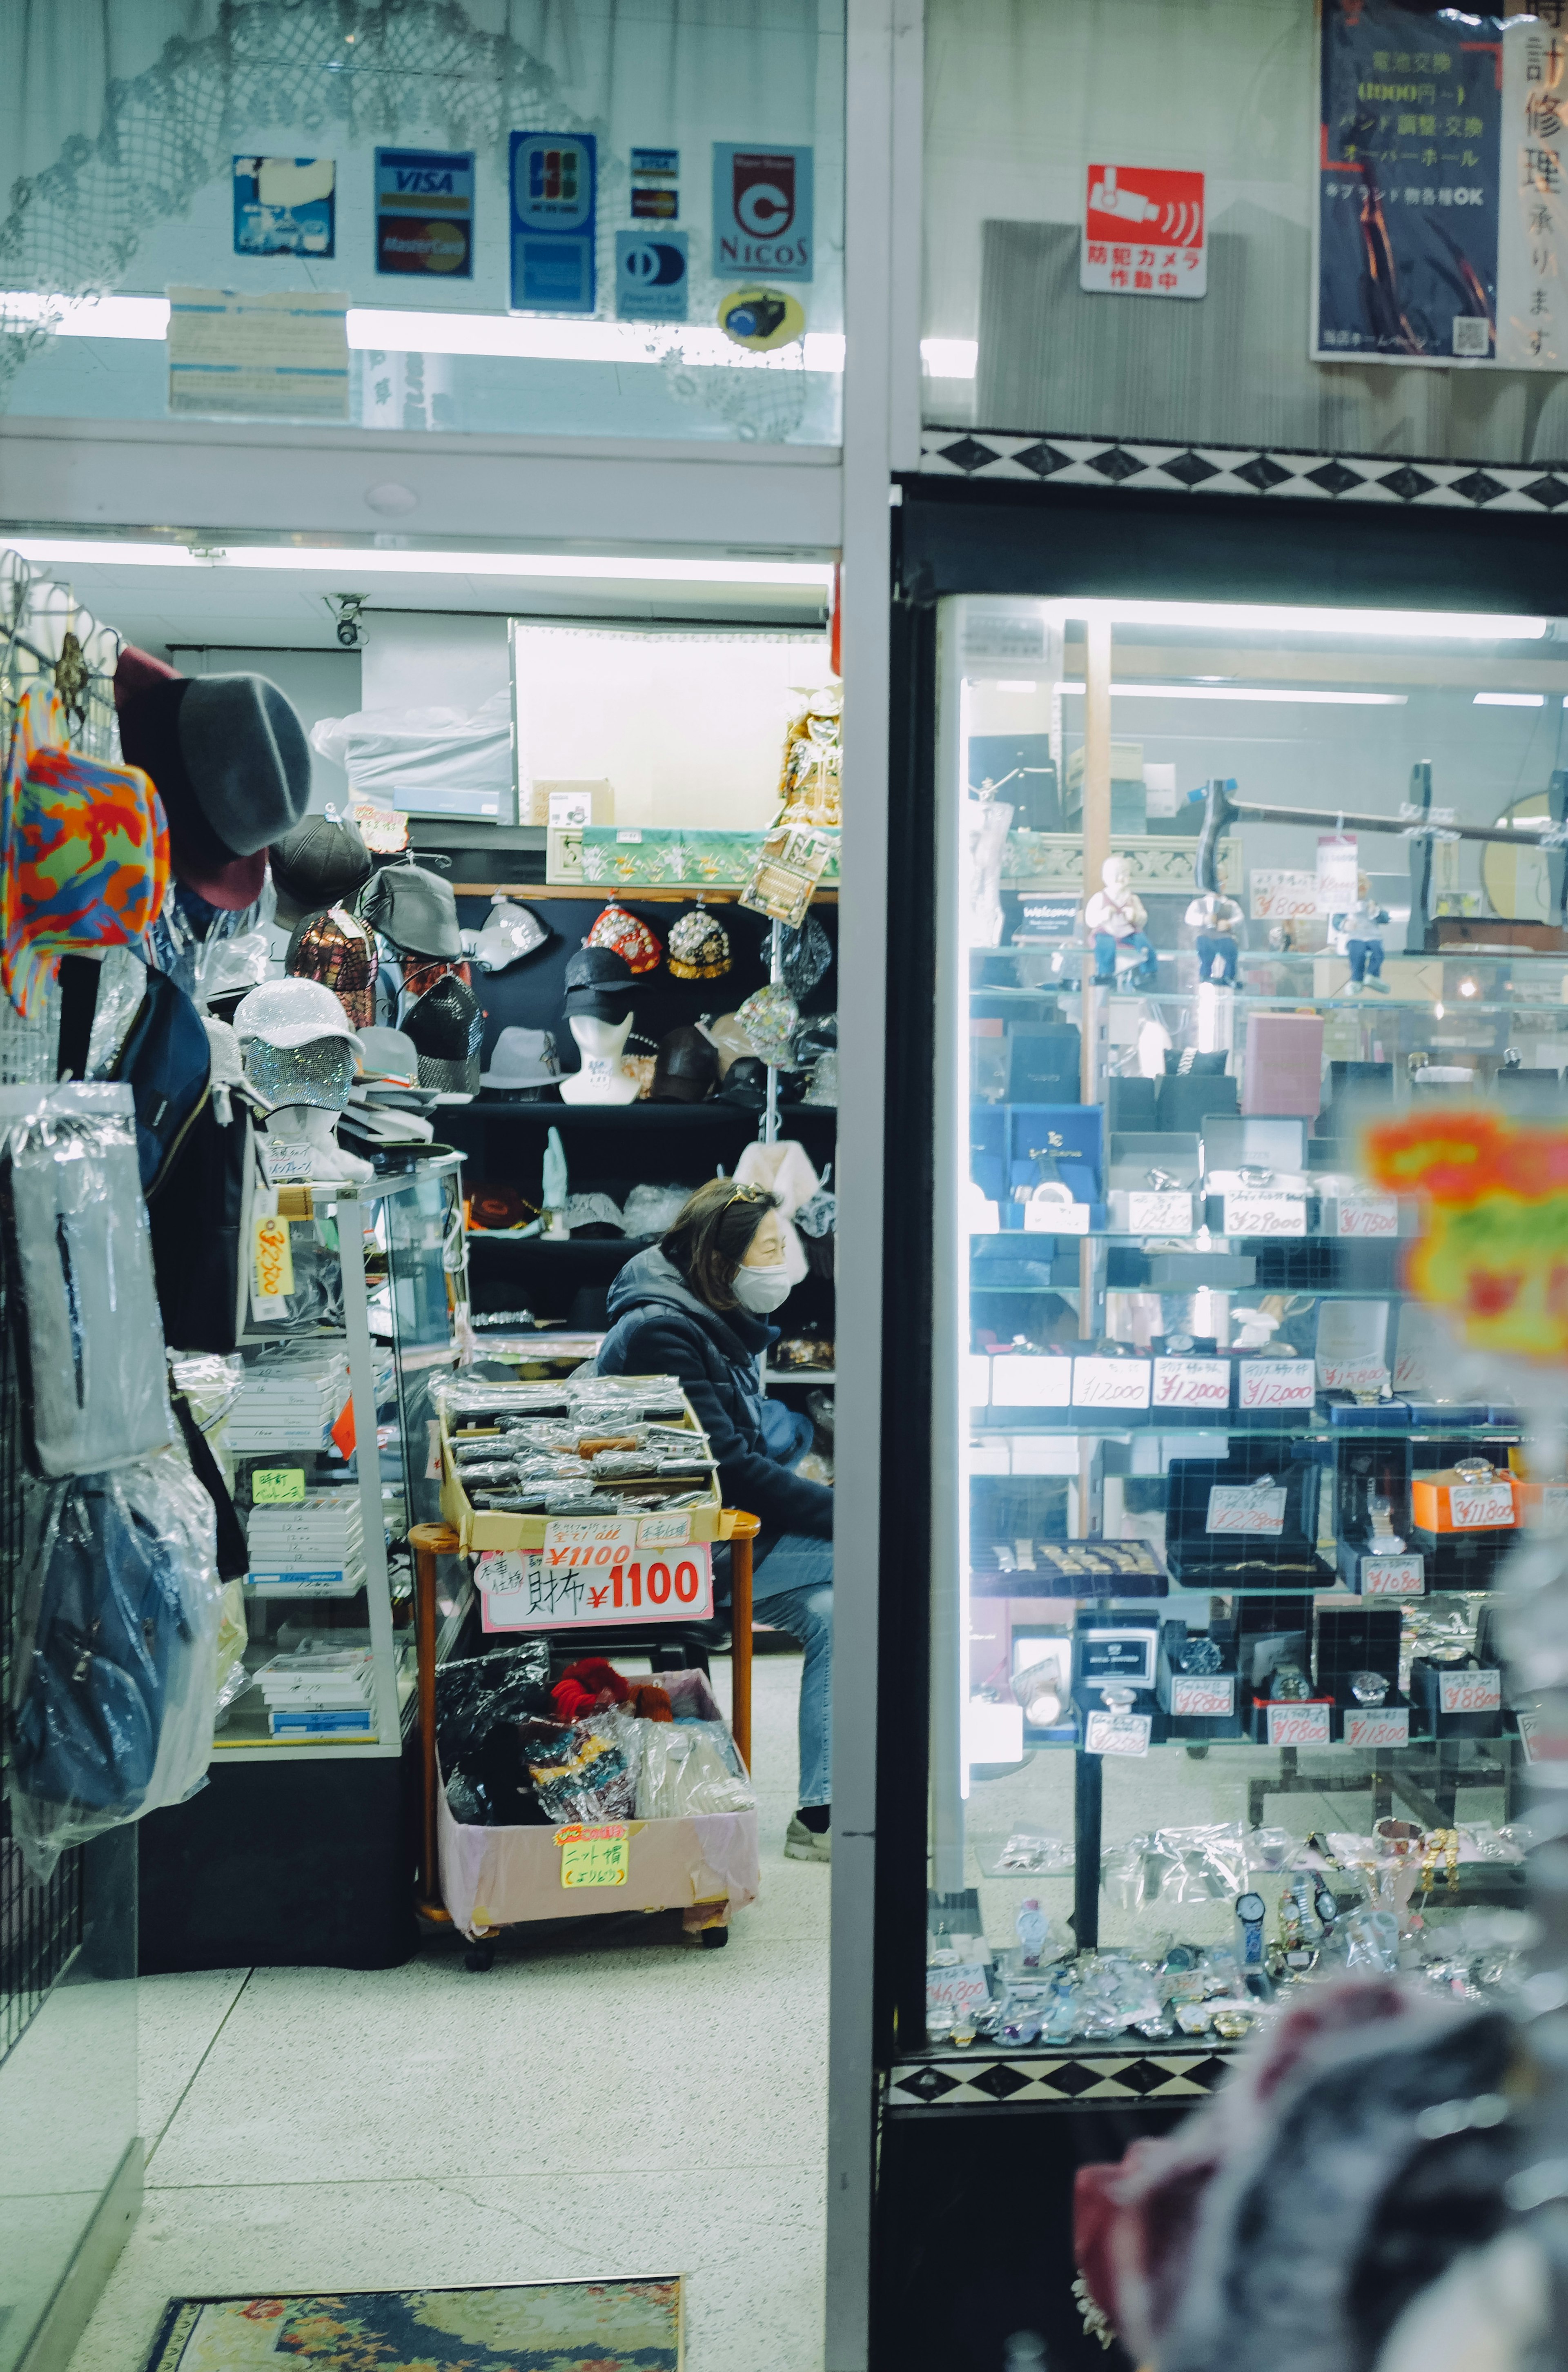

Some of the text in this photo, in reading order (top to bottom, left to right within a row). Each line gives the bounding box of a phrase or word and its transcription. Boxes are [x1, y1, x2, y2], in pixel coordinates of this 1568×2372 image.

[397, 171, 453, 194] VISA
[720, 236, 808, 267] NICOS
[1087, 245, 1200, 270] 防犯カメラ
[1111, 269, 1178, 292] 作動中
[596, 1528, 621, 1541] all
[526, 1569, 584, 1616] 財布
